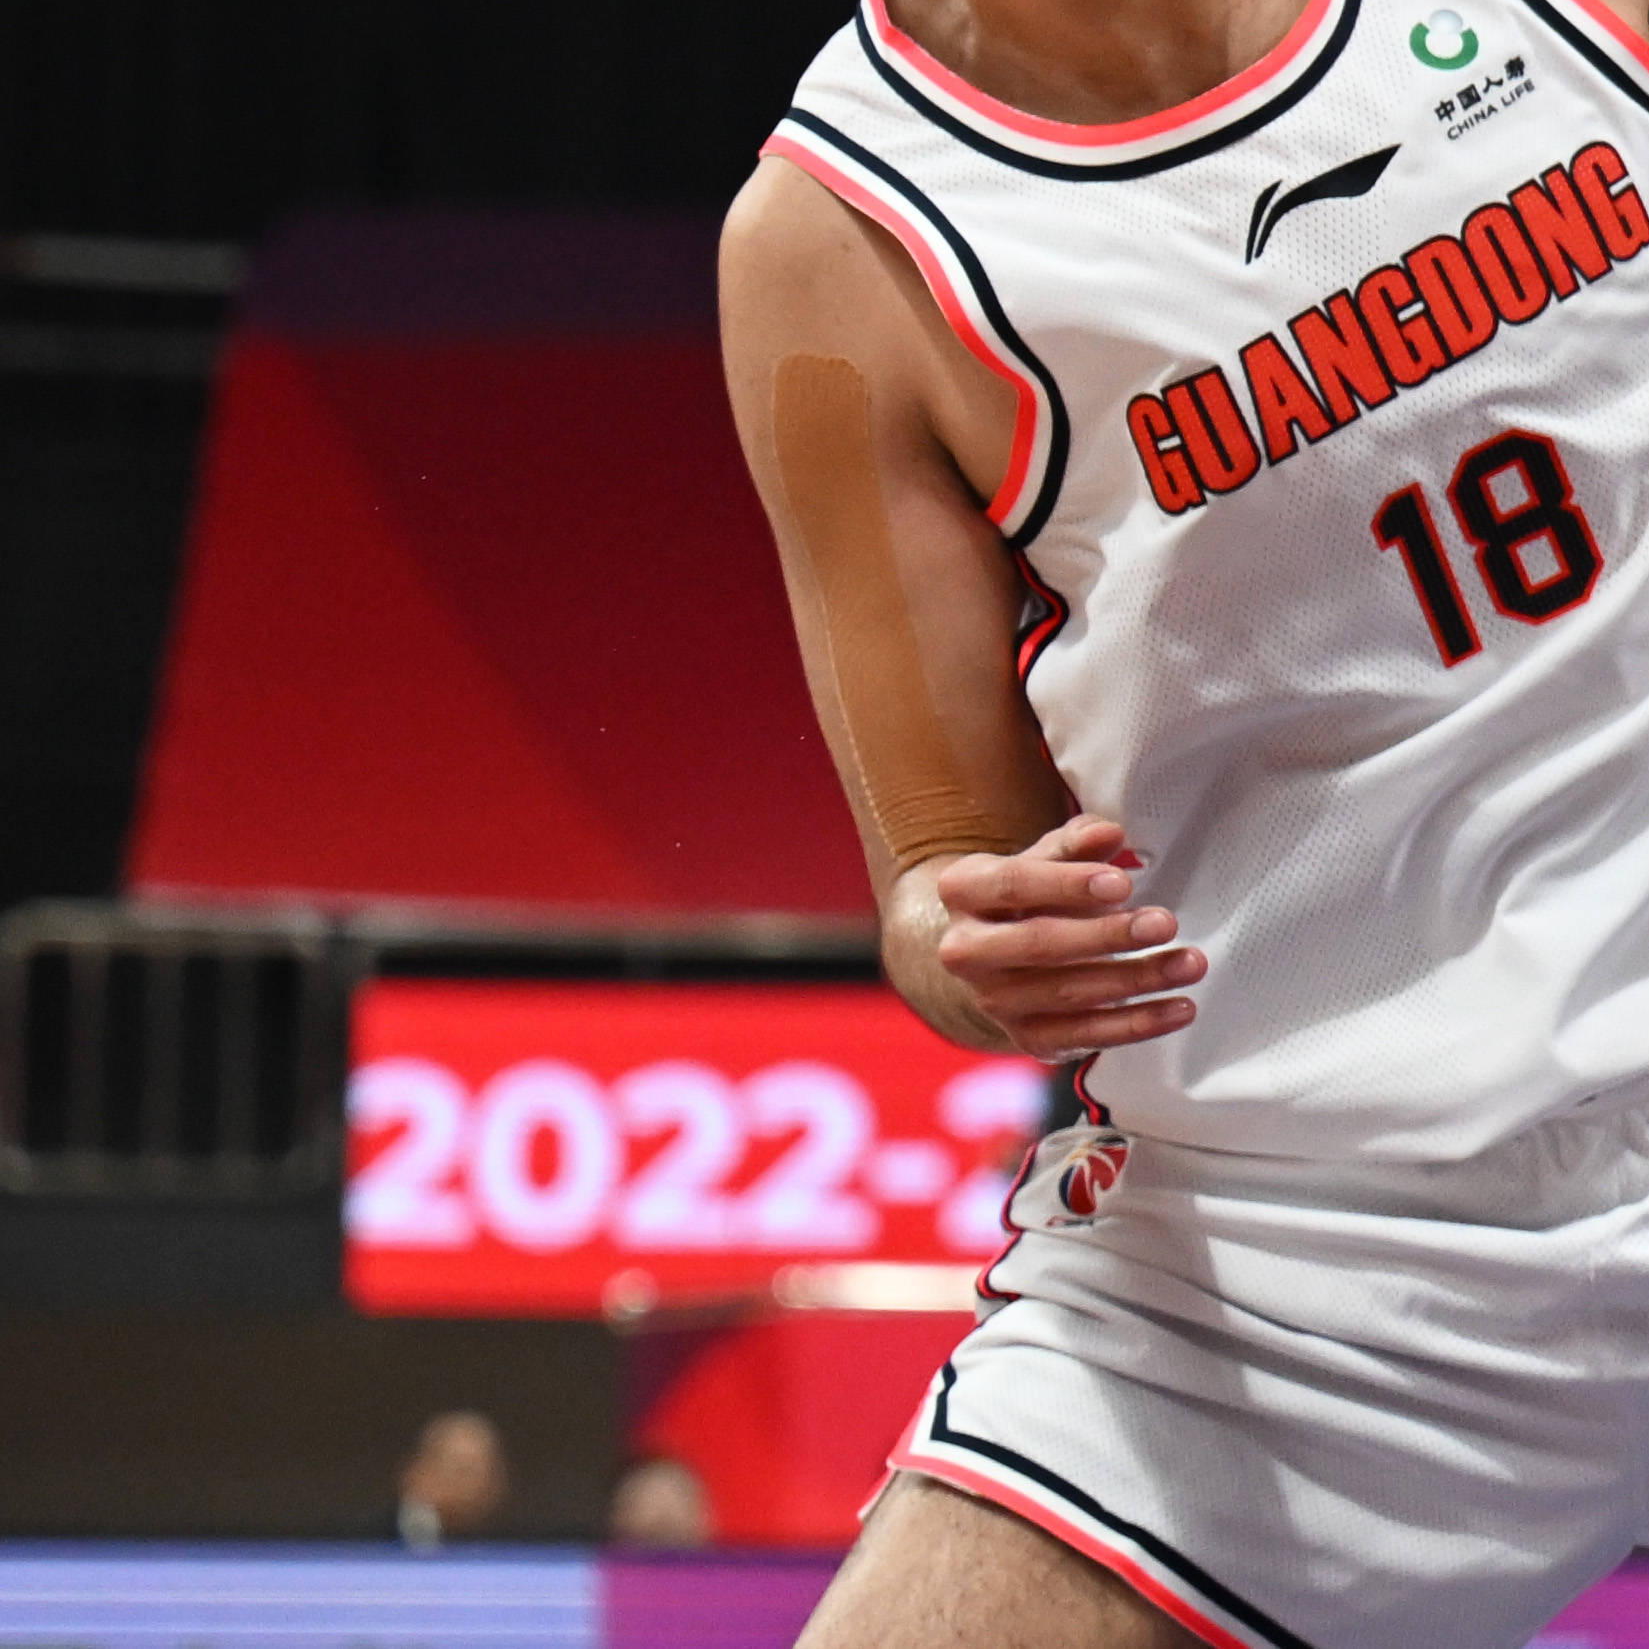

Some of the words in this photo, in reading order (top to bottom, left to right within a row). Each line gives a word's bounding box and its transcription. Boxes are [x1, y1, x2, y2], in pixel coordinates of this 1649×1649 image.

[1434, 54, 1526, 122] 中国人寿
[1447, 104, 1498, 141] CHINA
[1500, 78, 1535, 107] LIFE
[1370, 427, 1605, 669] 18
